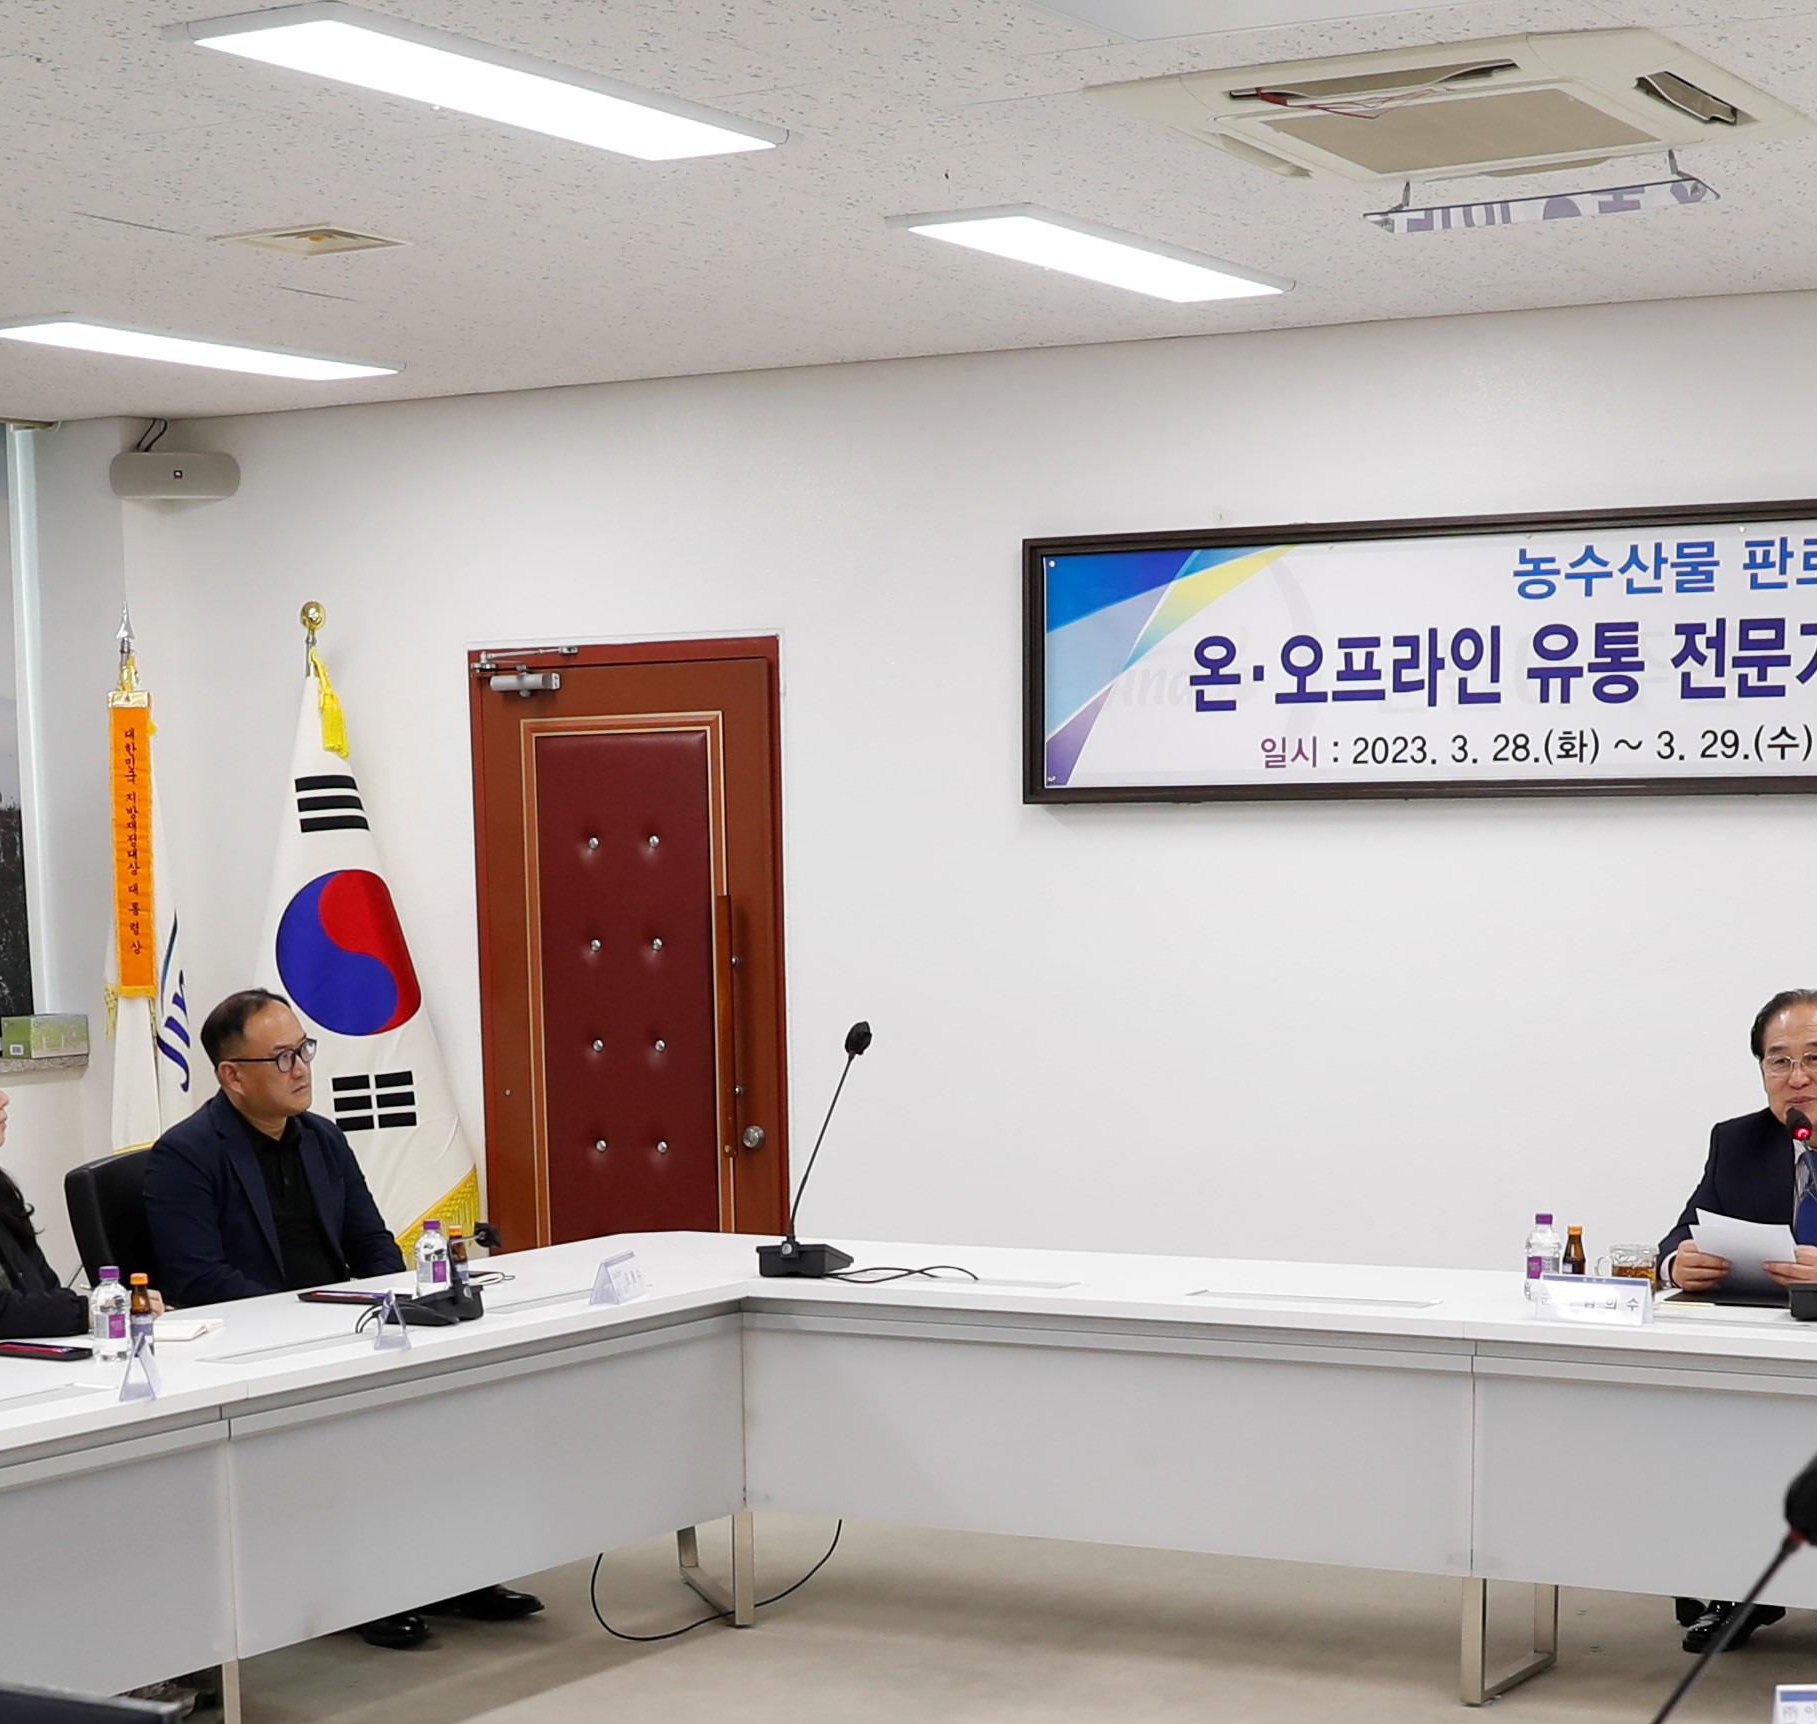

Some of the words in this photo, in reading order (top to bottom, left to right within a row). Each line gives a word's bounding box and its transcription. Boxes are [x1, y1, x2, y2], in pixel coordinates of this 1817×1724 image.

[1513, 541, 1720, 600] 농수산물
[1189, 625, 1501, 712] 온·오프라인
[1527, 621, 1645, 704] 유통
[124, 727, 137, 784] 대한민국
[1261, 736, 1317, 769] 일시
[1352, 736, 1437, 765] 2023.
[1451, 735, 1478, 764] 3.
[1492, 728, 1599, 765] 28.(화)
[1657, 730, 1685, 761] 3.
[1700, 724, 1812, 762] 29.(수)
